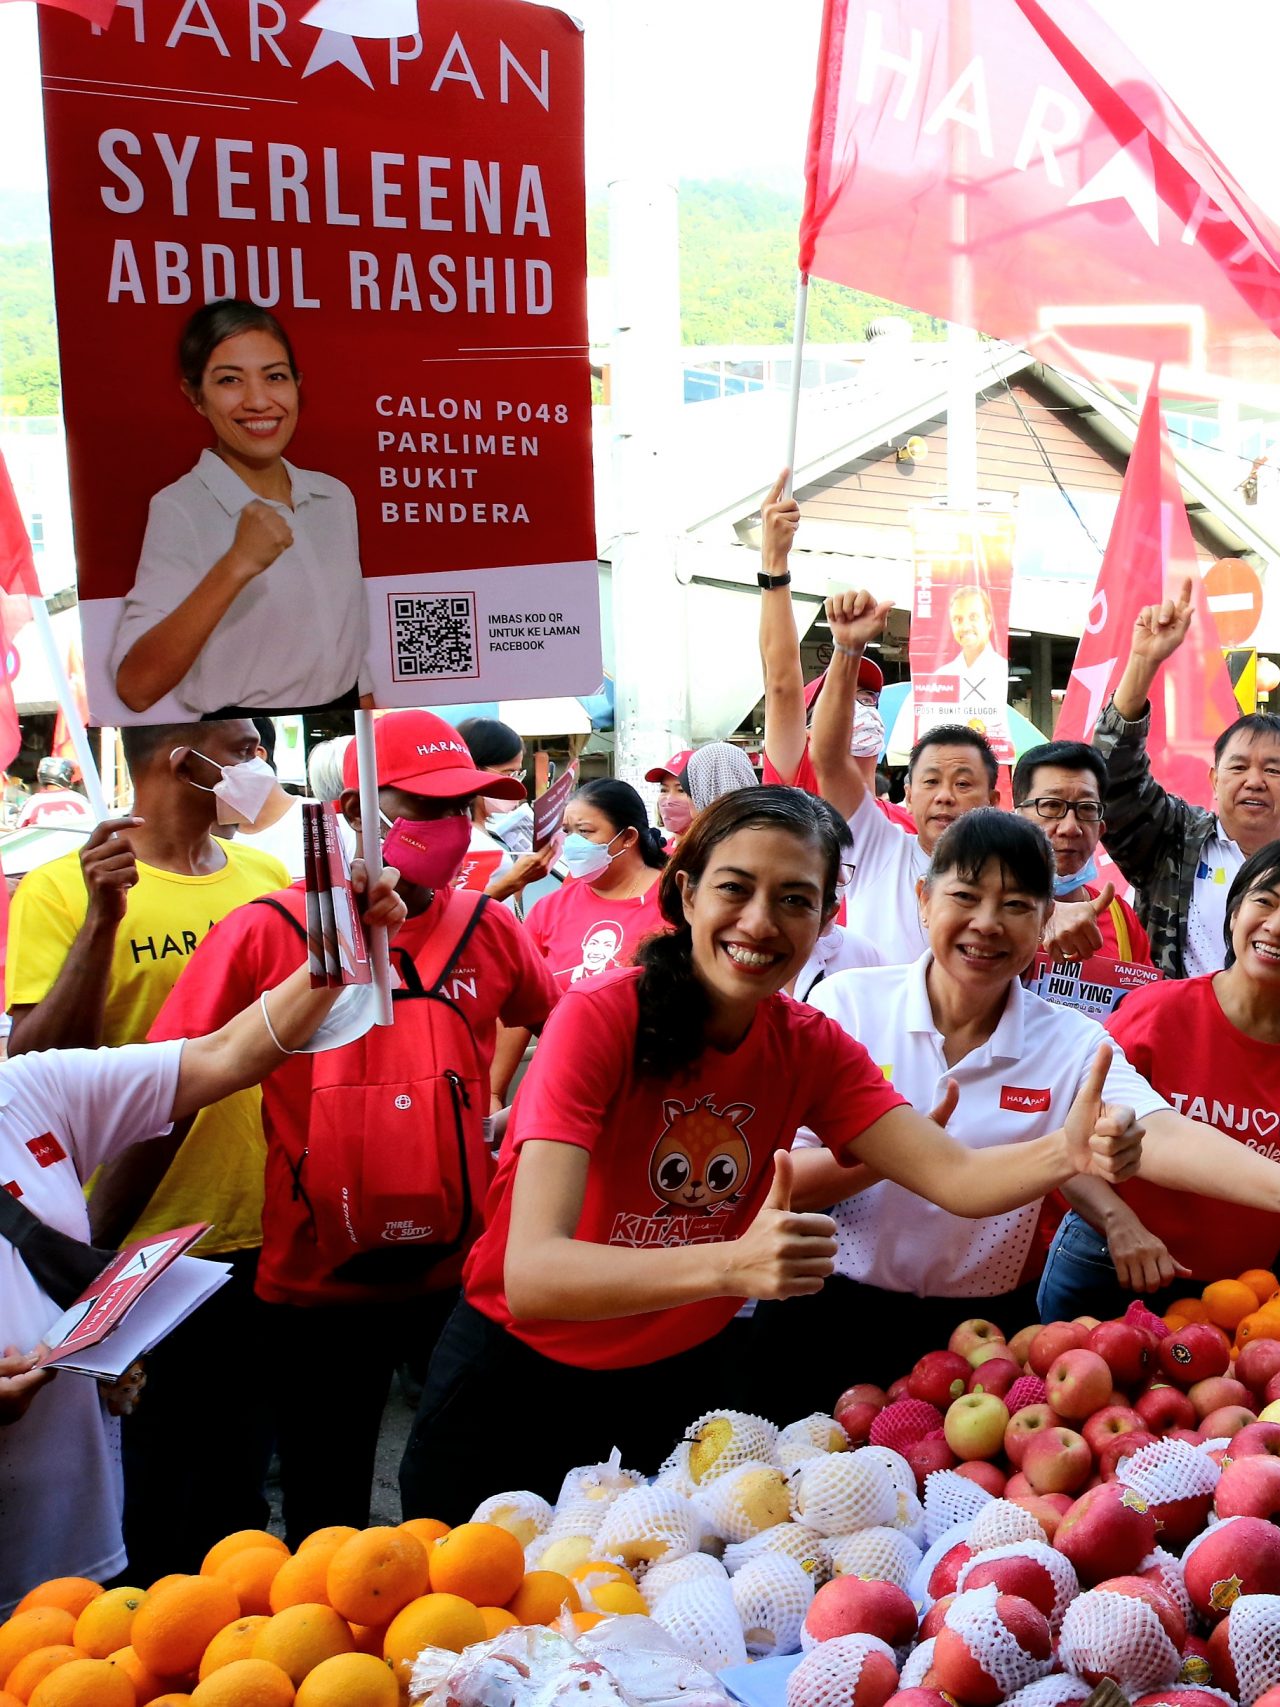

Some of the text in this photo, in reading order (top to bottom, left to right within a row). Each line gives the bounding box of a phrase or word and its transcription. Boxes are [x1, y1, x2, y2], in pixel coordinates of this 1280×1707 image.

[97, 128, 551, 237] SYERLEENA
[107, 239, 552, 315] ABDUL RASHID
[375, 395, 569, 424] CALON P048
[377, 431, 539, 457] PARLIMEN
[379, 466, 478, 489] BUKIT
[381, 502, 530, 524] BENDERA
[488, 613, 563, 625] IMBAS KOD QR
[488, 625, 580, 638] UNTUK KE LAMAN
[489, 641, 545, 652] FACEBOOK
[130, 919, 215, 964] HAR
[1048, 976, 1113, 1005] HUI YING
[1006, 1094, 1046, 1106] HARAPAN
[385, 1220, 414, 1230] THREE
[400, 1226, 427, 1237] SIXTY
[610, 1212, 689, 1244] KITA
